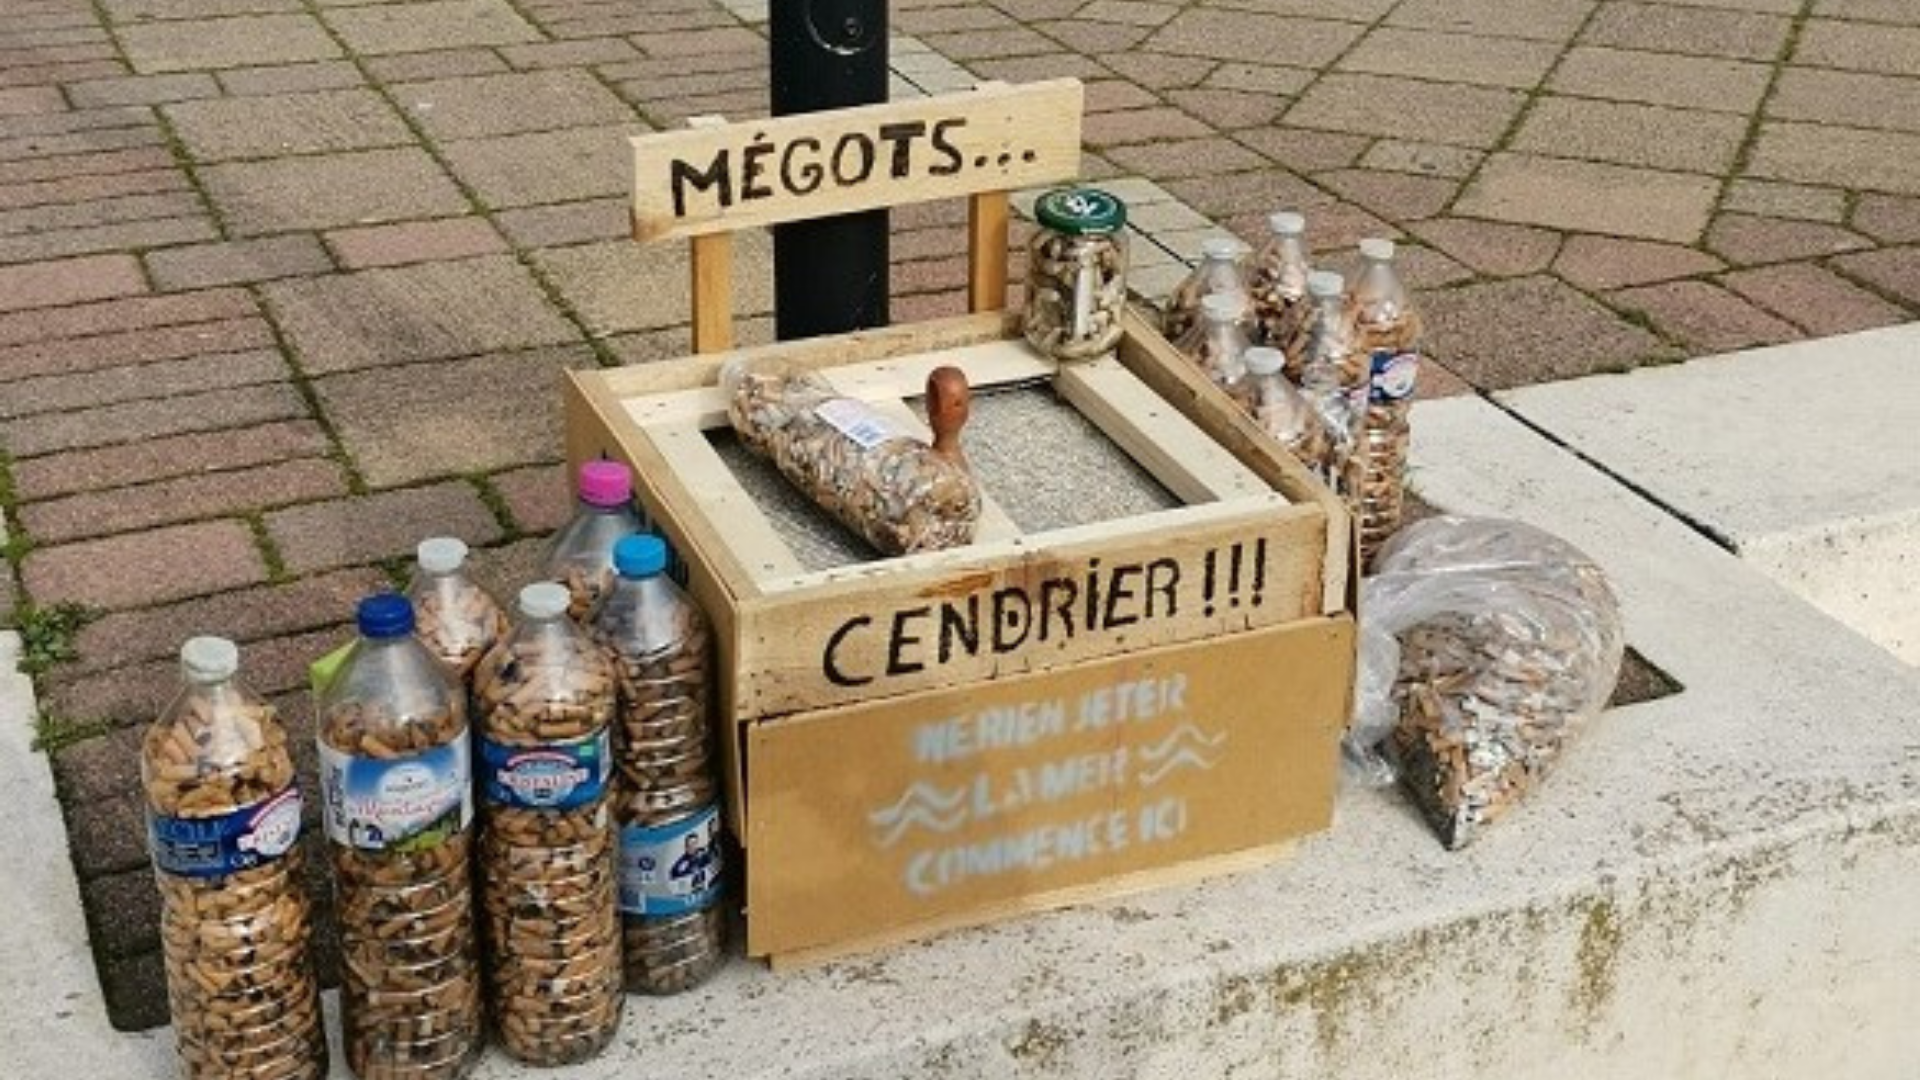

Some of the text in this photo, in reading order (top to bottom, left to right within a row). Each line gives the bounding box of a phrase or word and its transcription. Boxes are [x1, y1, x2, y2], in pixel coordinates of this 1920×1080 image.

[670, 118, 1037, 218] MÉGOTS...
[1202, 537, 1267, 617] !!!
[914, 673, 1188, 763] NE RIEN JETER
[970, 746, 1129, 821] LA MER
[906, 797, 1188, 894] COMMENCE ICI
